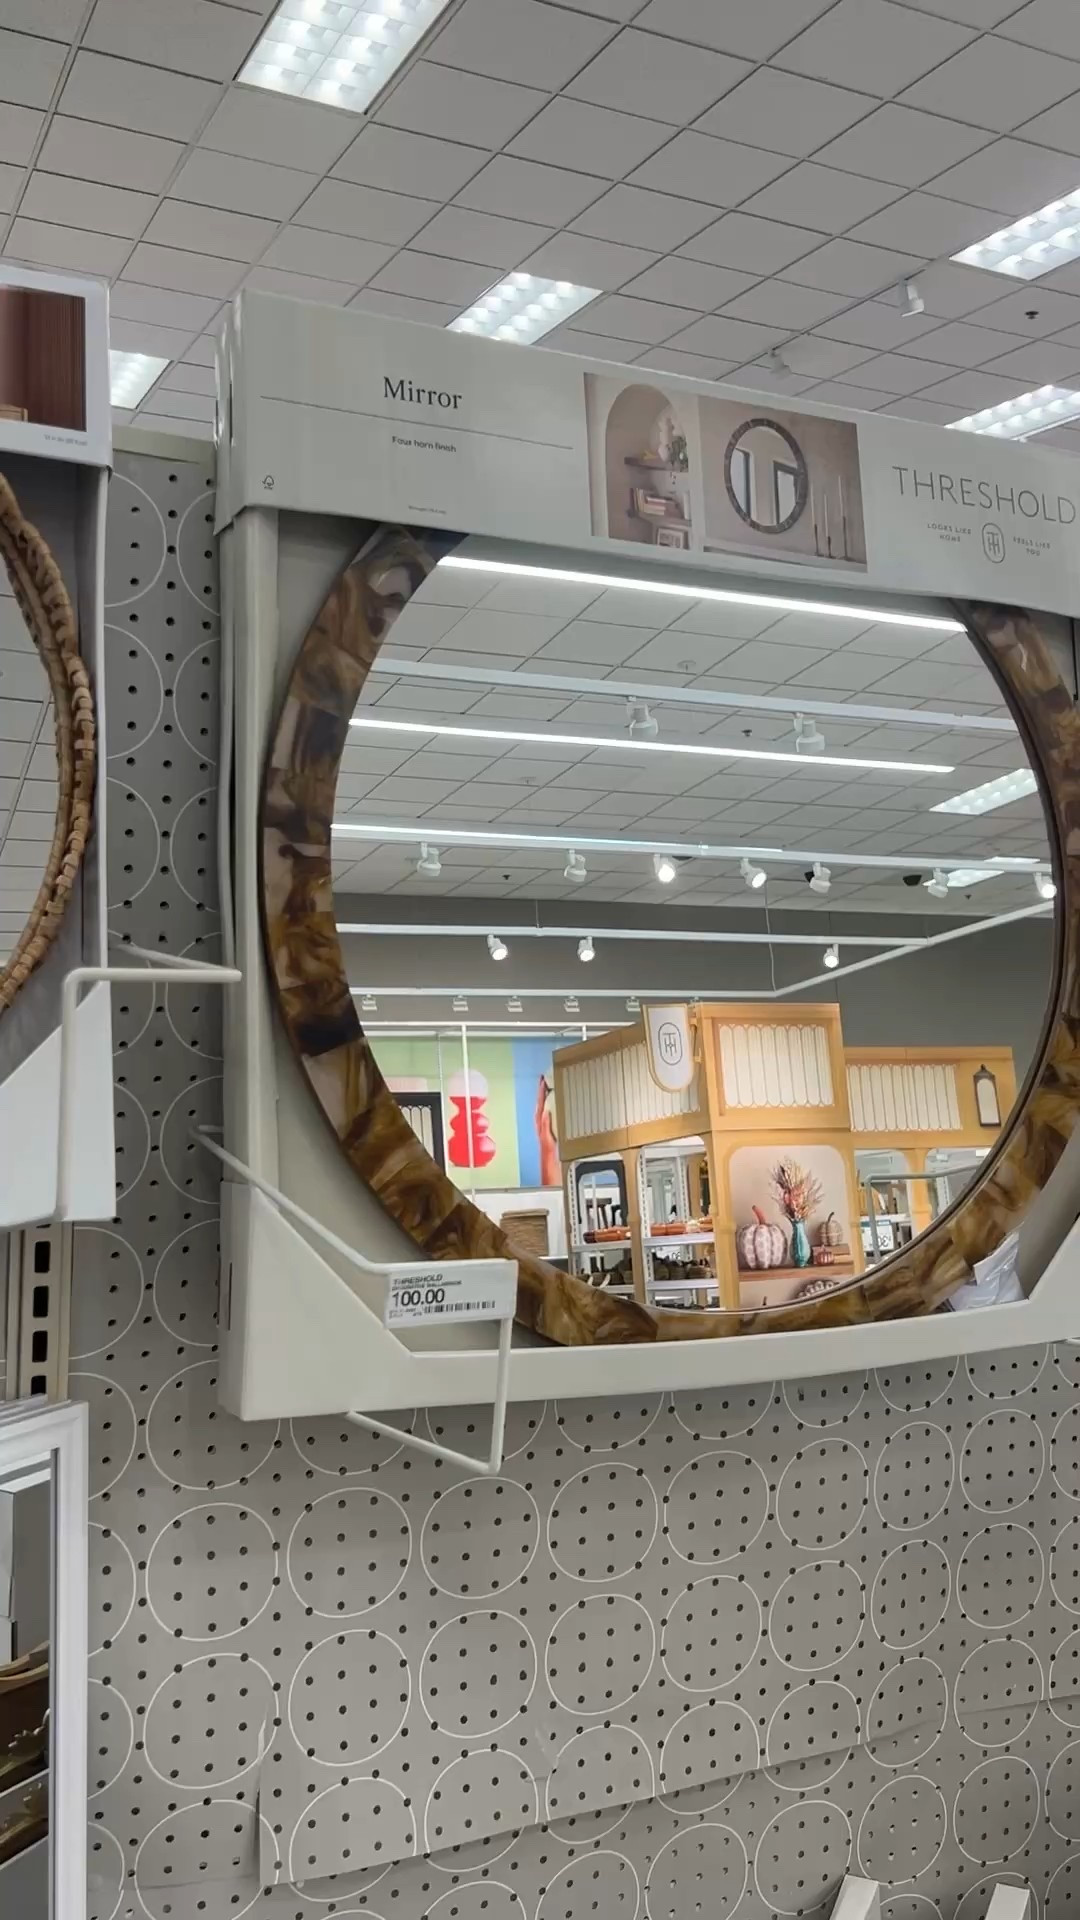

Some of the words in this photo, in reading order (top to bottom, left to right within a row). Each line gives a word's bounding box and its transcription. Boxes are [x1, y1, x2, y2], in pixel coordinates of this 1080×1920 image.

[383, 376, 462, 409] Mirror
[414, 439, 434, 449] horn
[435, 442, 457, 453] finish
[892, 465, 1076, 524] THRESHOLD
[393, 1273, 443, 1285] THRESHOLD
[392, 1288, 445, 1307] 100.00
